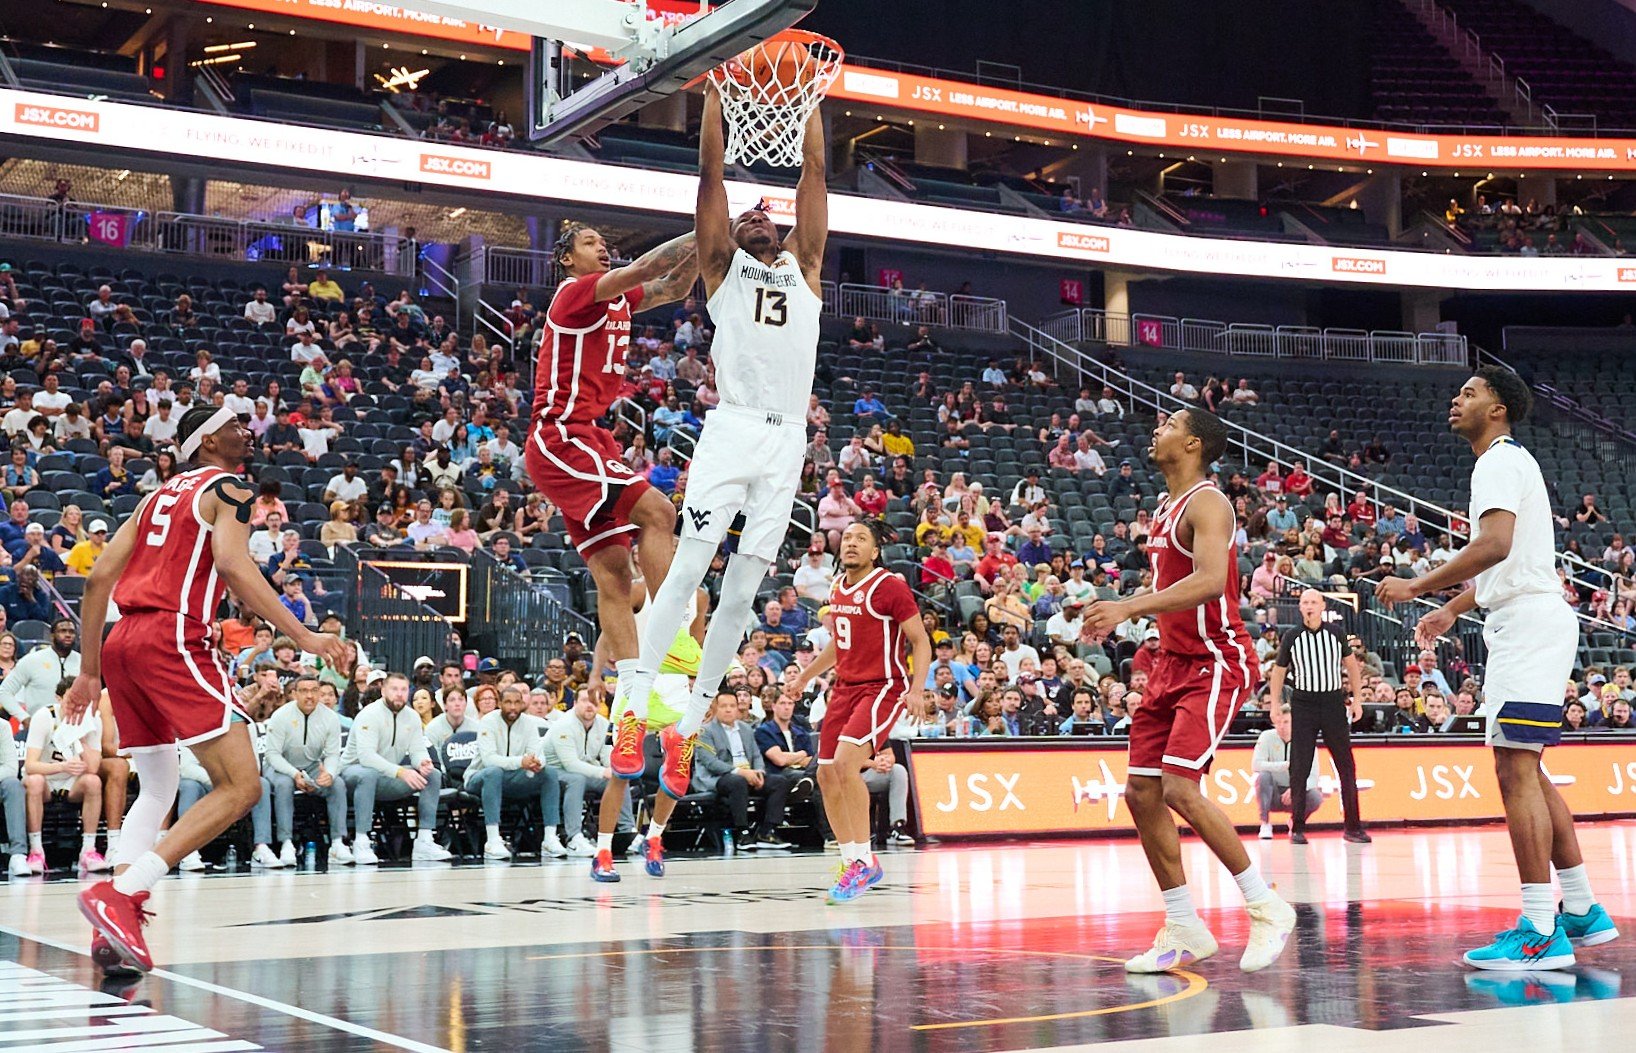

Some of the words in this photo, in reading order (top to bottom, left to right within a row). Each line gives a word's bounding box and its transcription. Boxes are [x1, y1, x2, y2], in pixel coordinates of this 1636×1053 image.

[912, 85, 942, 102] JSX
[949, 92, 974, 106] LESS
[1019, 102, 1047, 118] MORE
[19, 107, 95, 129] JSX.COM
[1179, 123, 1209, 138] JSX
[1216, 127, 1242, 140] LESS
[1287, 132, 1316, 146] MORE
[1452, 144, 1483, 158] JSX
[1490, 146, 1517, 157] LESS
[1565, 148, 1596, 158] MORE
[423, 157, 488, 177] JSX.COM
[97, 219, 118, 240] 16
[1059, 235, 1107, 249] JSX.COM
[1334, 259, 1384, 274] JSX.COM
[1064, 283, 1078, 298] 14
[754, 287, 788, 327] 13
[1143, 326, 1158, 342] 14
[766, 412, 783, 427] WVU
[146, 494, 180, 547] 5
[835, 616, 852, 650] 9
[1410, 764, 1481, 800] JSX
[935, 772, 1026, 812] JSX
